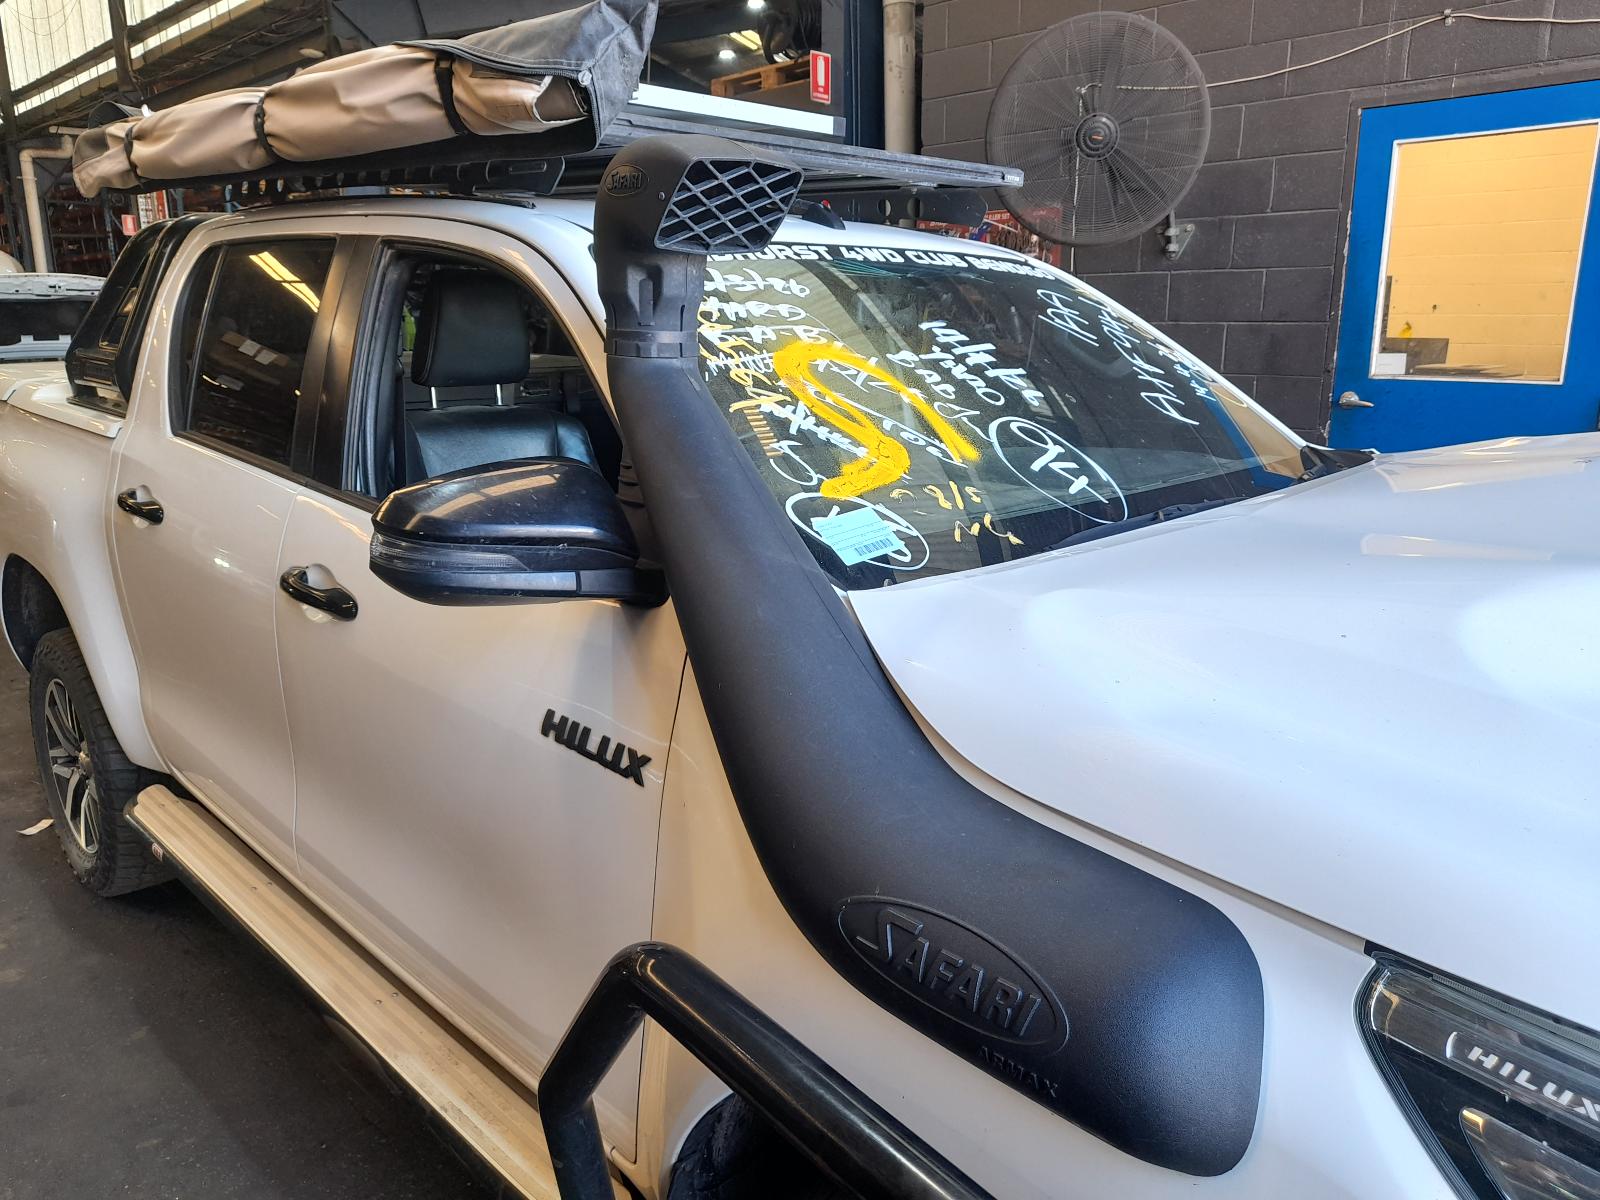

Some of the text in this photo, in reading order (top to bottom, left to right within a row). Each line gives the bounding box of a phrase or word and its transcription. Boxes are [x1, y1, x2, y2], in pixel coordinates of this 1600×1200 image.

[605, 169, 642, 190] SAFARI
[841, 246, 905, 263] 4WD
[904, 250, 970, 269] CLUB
[965, 256, 1056, 280] BENDIGO
[541, 708, 653, 788] HILUX
[855, 906, 1042, 1037] SAFARI
[1467, 1045, 1600, 1122] HILUX
